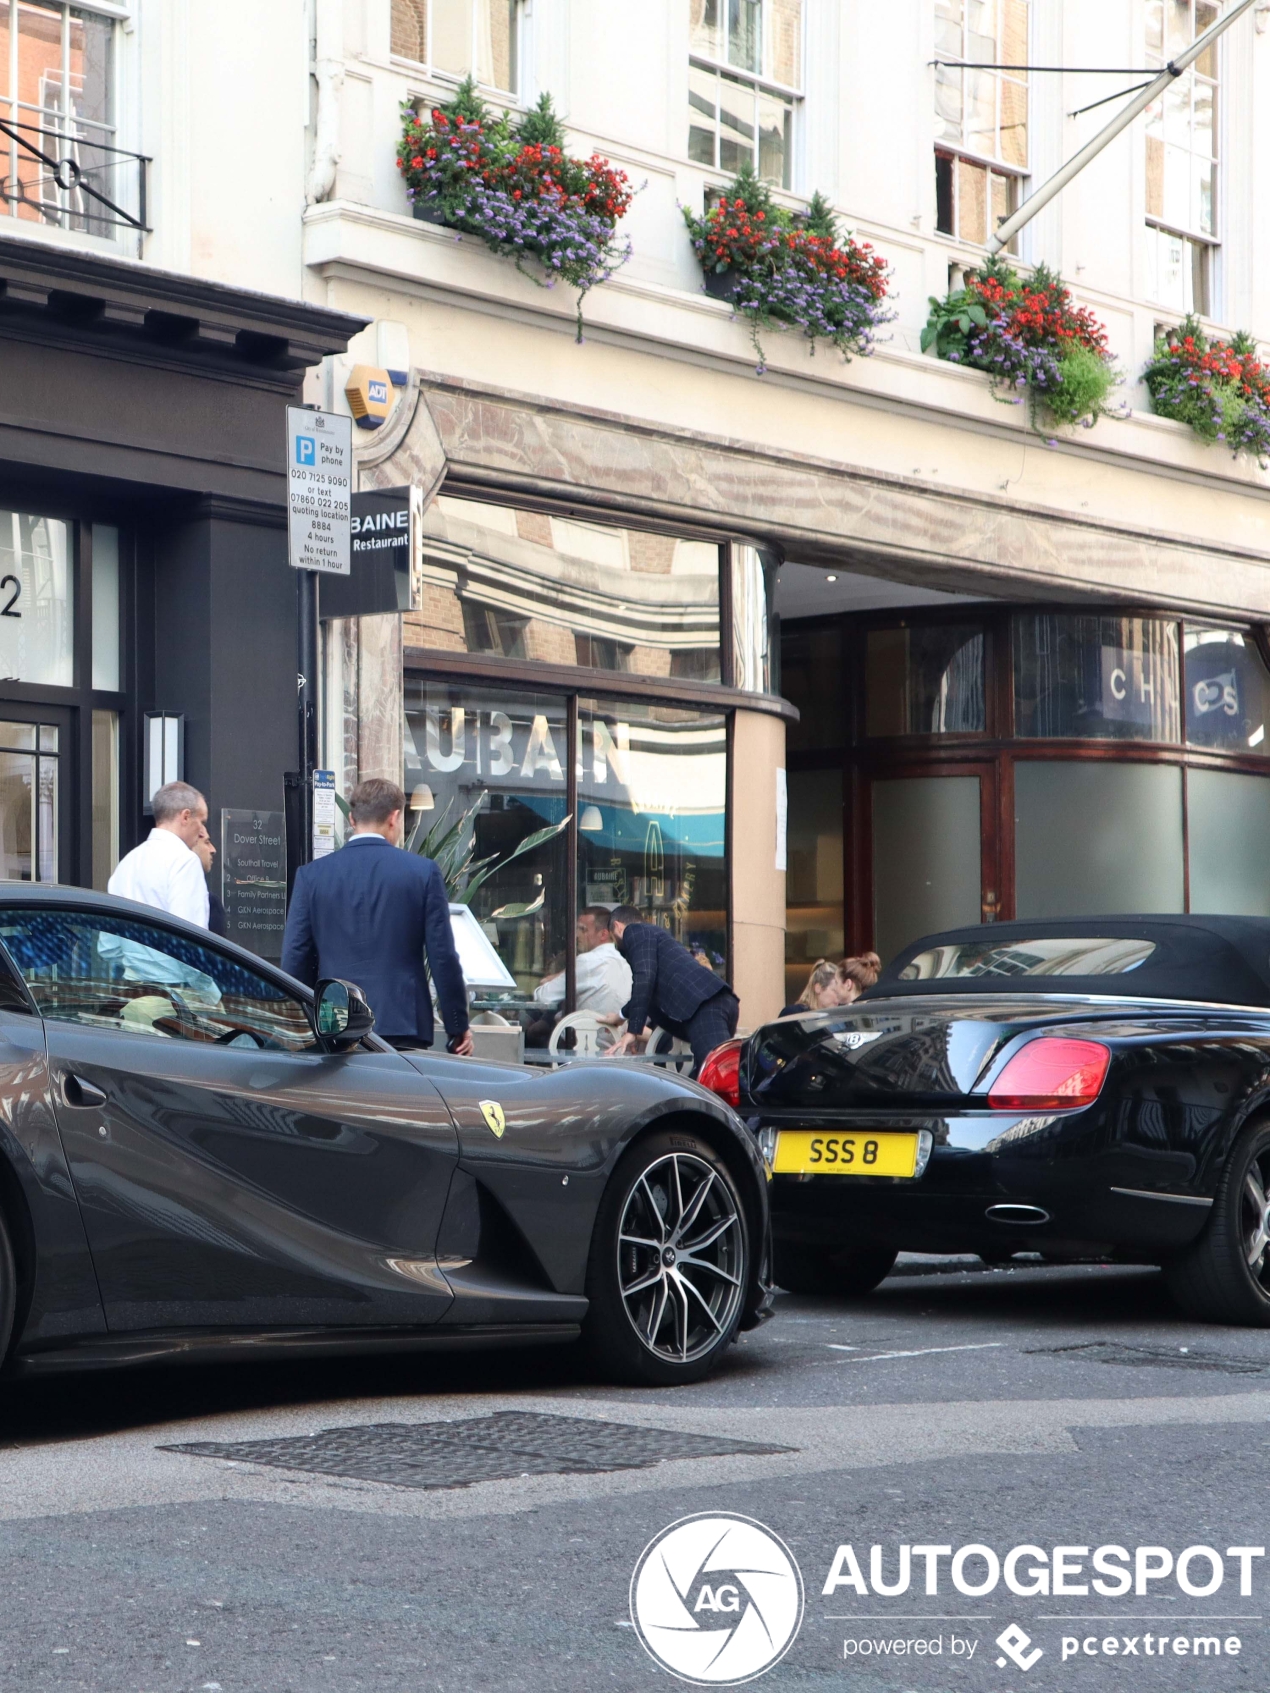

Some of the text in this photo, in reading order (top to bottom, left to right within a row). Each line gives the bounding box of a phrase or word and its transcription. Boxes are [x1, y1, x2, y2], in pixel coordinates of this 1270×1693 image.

[369, 384, 387, 400] ADT
[300, 439, 313, 462] P
[320, 442, 344, 456] Pay by
[321, 455, 343, 467] phone
[291, 468, 348, 488] 020 7125 9090
[307, 486, 332, 497] or text
[290, 493, 349, 511] 07860 022 205
[292, 505, 349, 521] quoting location
[311, 520, 331, 531] 8884
[351, 510, 409, 534] BAINE
[307, 531, 335, 544] 4 hours
[353, 533, 409, 552] Restaurant
[304, 544, 338, 557] No return
[299, 555, 321, 566] within
[327, 559, 343, 569] hour
[252, 819, 263, 830] 32
[233, 833, 281, 846] Dover Street
[237, 858, 260, 868] Southall
[261, 859, 279, 869] Travel
[226, 873, 231, 882] 2
[226, 890, 231, 898] 3
[237, 890, 257, 900] Family
[257, 890, 280, 900] Partners
[226, 905, 285, 916] 4 GKN Aerospace
[226, 920, 285, 931] 5 GKN Aerospace
[809, 1138, 879, 1165] SSS 8
